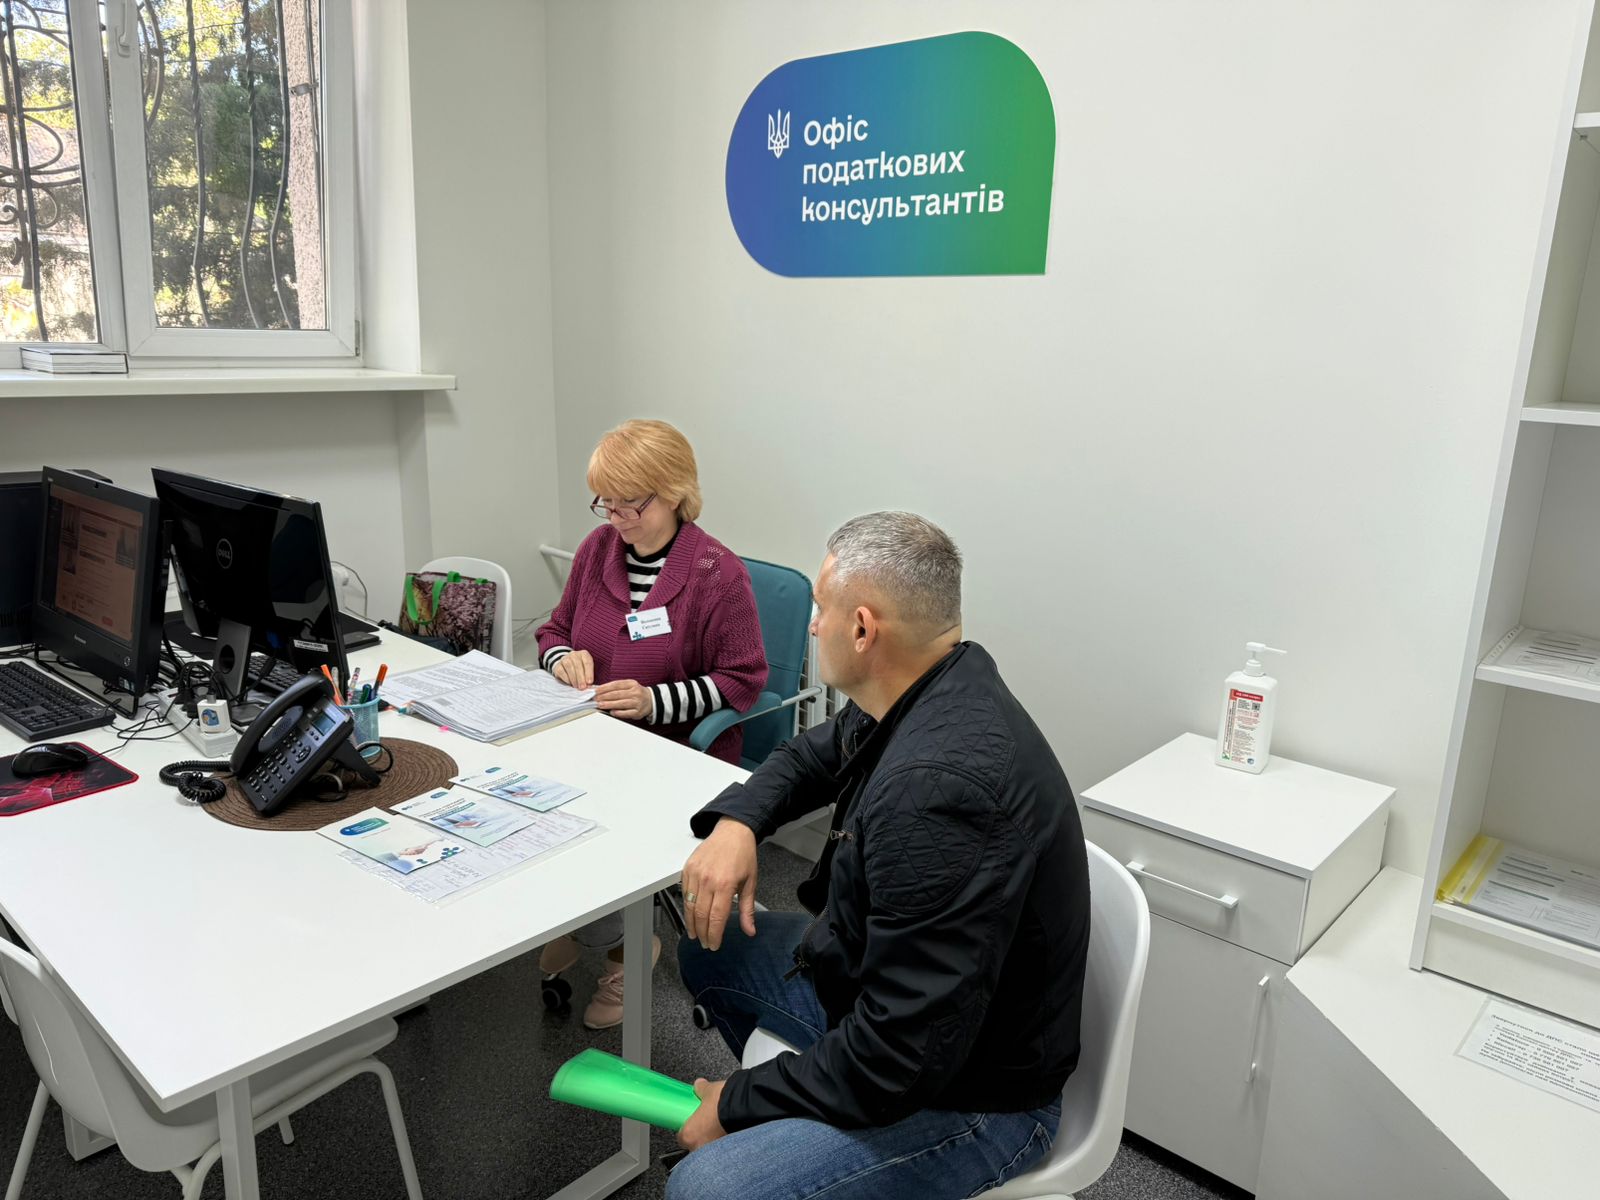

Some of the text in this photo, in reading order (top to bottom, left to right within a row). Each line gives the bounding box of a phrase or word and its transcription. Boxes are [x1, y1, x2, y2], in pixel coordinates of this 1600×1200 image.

[804, 115, 868, 149] Офіс
[803, 150, 965, 186] податкових
[802, 184, 1004, 225] консультантів
